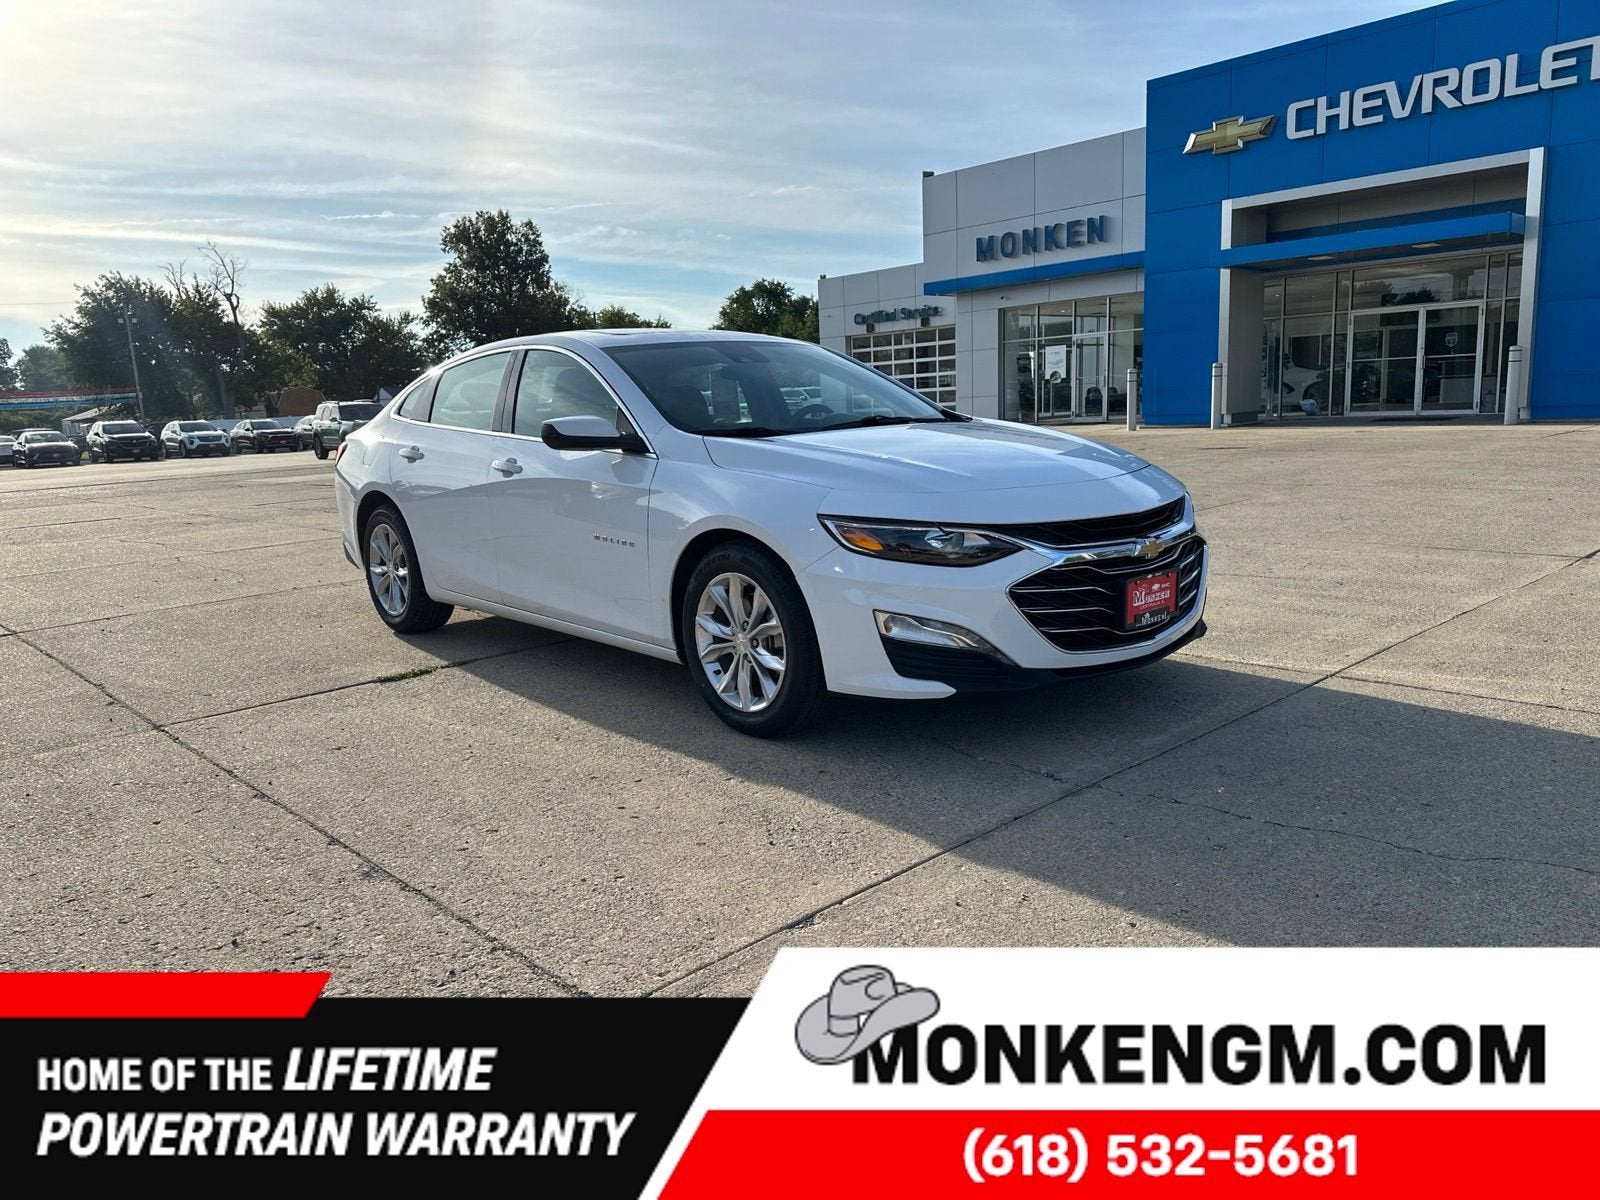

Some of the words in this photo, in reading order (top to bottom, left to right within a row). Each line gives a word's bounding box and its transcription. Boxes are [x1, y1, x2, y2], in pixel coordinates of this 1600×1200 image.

[976, 215, 1109, 262] MONKEN
[854, 308, 898, 325] Certified
[900, 305, 943, 320] Service
